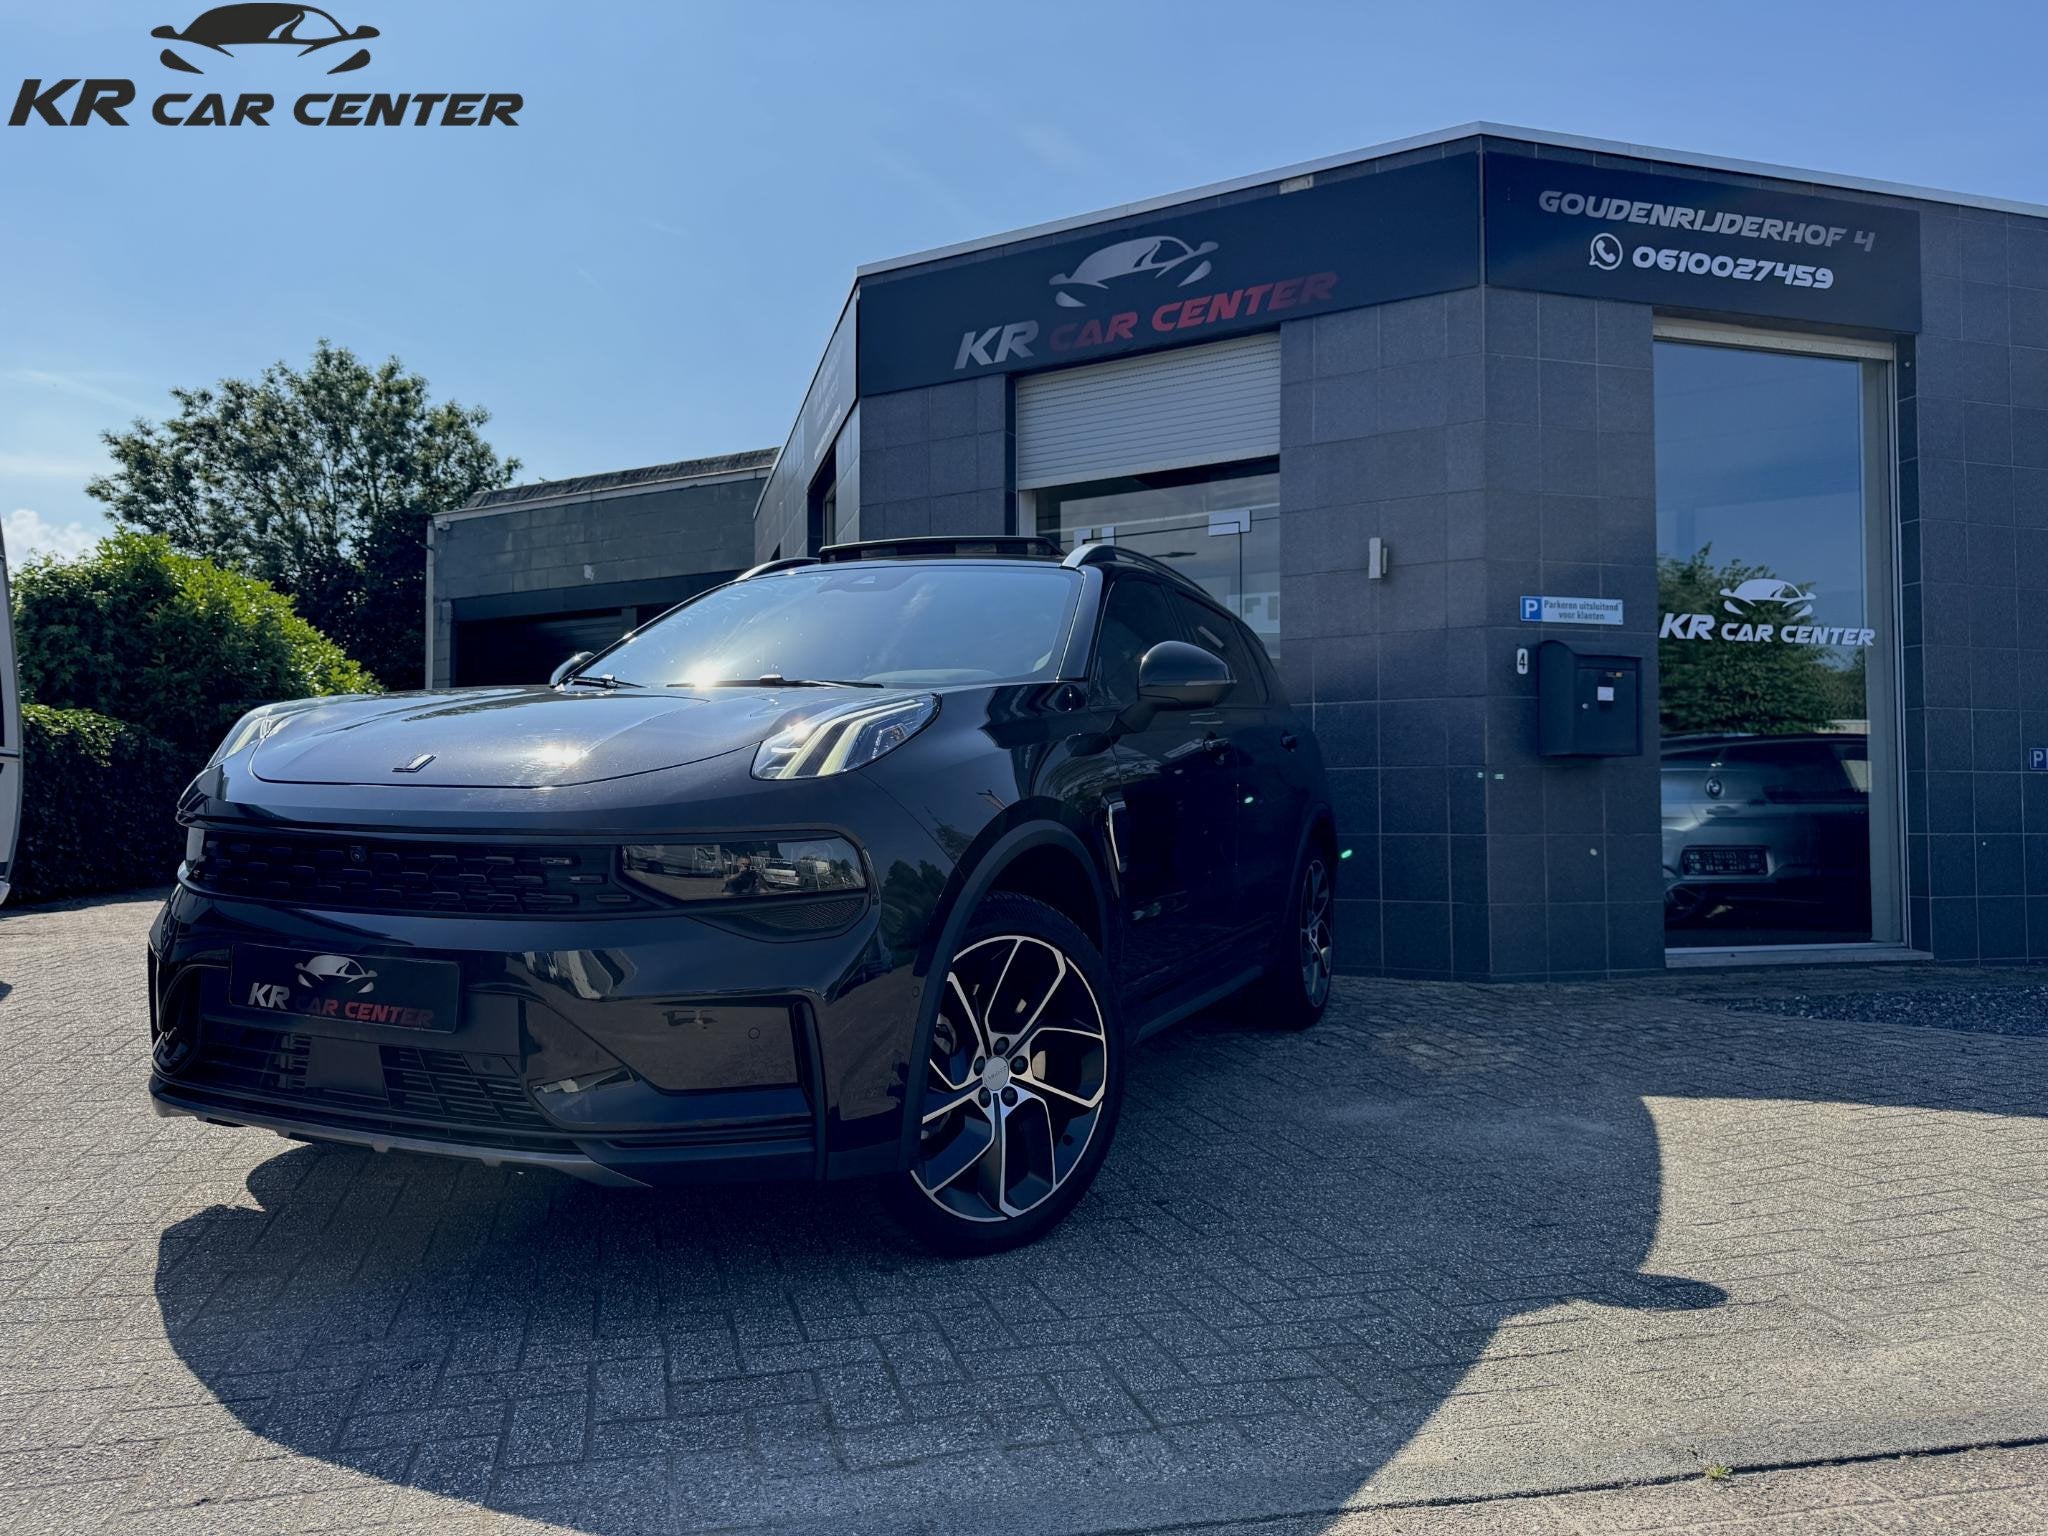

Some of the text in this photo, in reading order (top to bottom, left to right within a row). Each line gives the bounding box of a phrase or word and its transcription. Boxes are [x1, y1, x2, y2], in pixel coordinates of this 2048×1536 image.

[1539, 190, 1875, 252] GOUDENRIJDERHOF 4
[1632, 246, 1834, 290] 0610027459
[954, 271, 1337, 370] KR CAR CENTER
[1525, 600, 1538, 618] P
[1543, 599, 1619, 612] Parkeren uitsluitend
[1558, 610, 1605, 620] voor klanten
[1659, 613, 1876, 647] KR CAR CENTER
[1519, 652, 1527, 671] 4
[2033, 750, 2043, 767] P
[248, 982, 290, 1010] KR
[344, 1001, 435, 1027] CENTER
